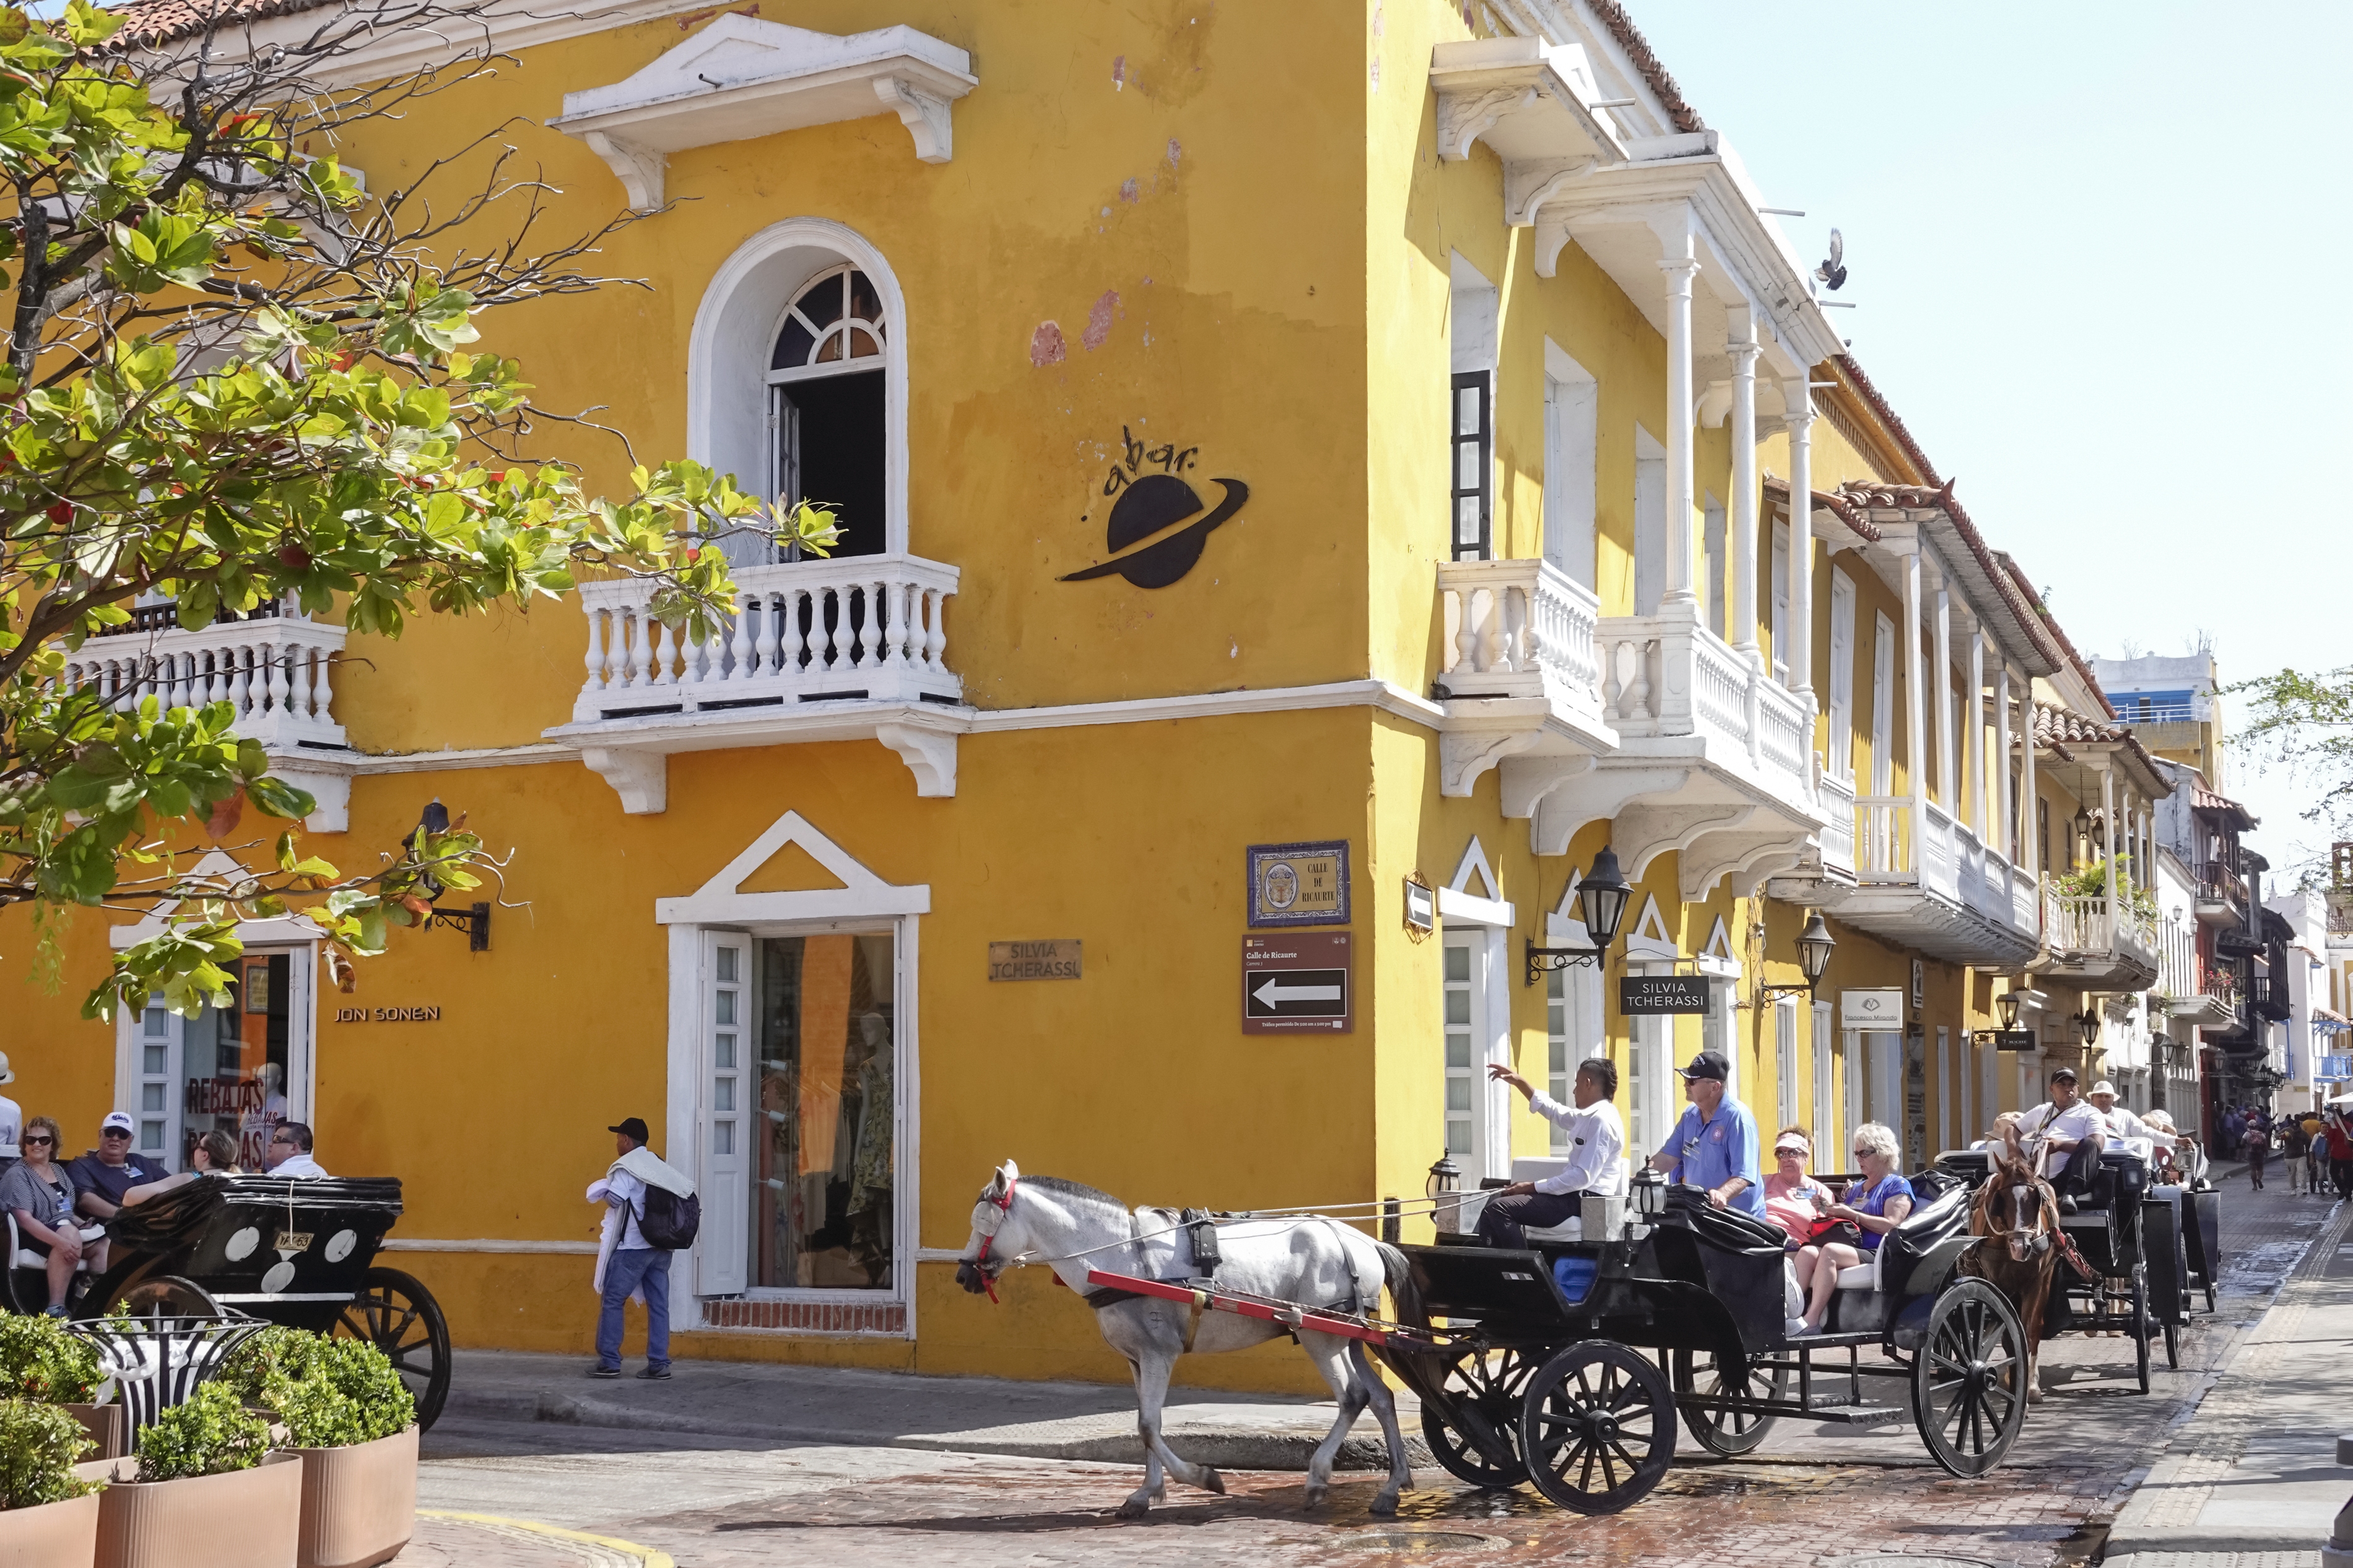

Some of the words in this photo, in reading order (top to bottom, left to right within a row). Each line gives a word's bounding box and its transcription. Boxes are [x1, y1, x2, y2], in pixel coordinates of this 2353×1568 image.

[1308, 863, 1328, 873] CALLE
[1314, 877, 1323, 887] DE
[1302, 891, 1335, 902] RICAURTE
[1011, 943, 1058, 959] SILVIA
[992, 961, 1077, 978] TCHERASSI
[1642, 983, 1687, 994] SILVIA
[1627, 995, 1703, 1007] TCHERASSI
[334, 1008, 368, 1022] JON
[374, 1007, 440, 1021] SONEN
[188, 1078, 264, 1114] REBAJAS
[247, 1111, 277, 1125] REBAJAS
[297, 1237, 309, 1246] 53
